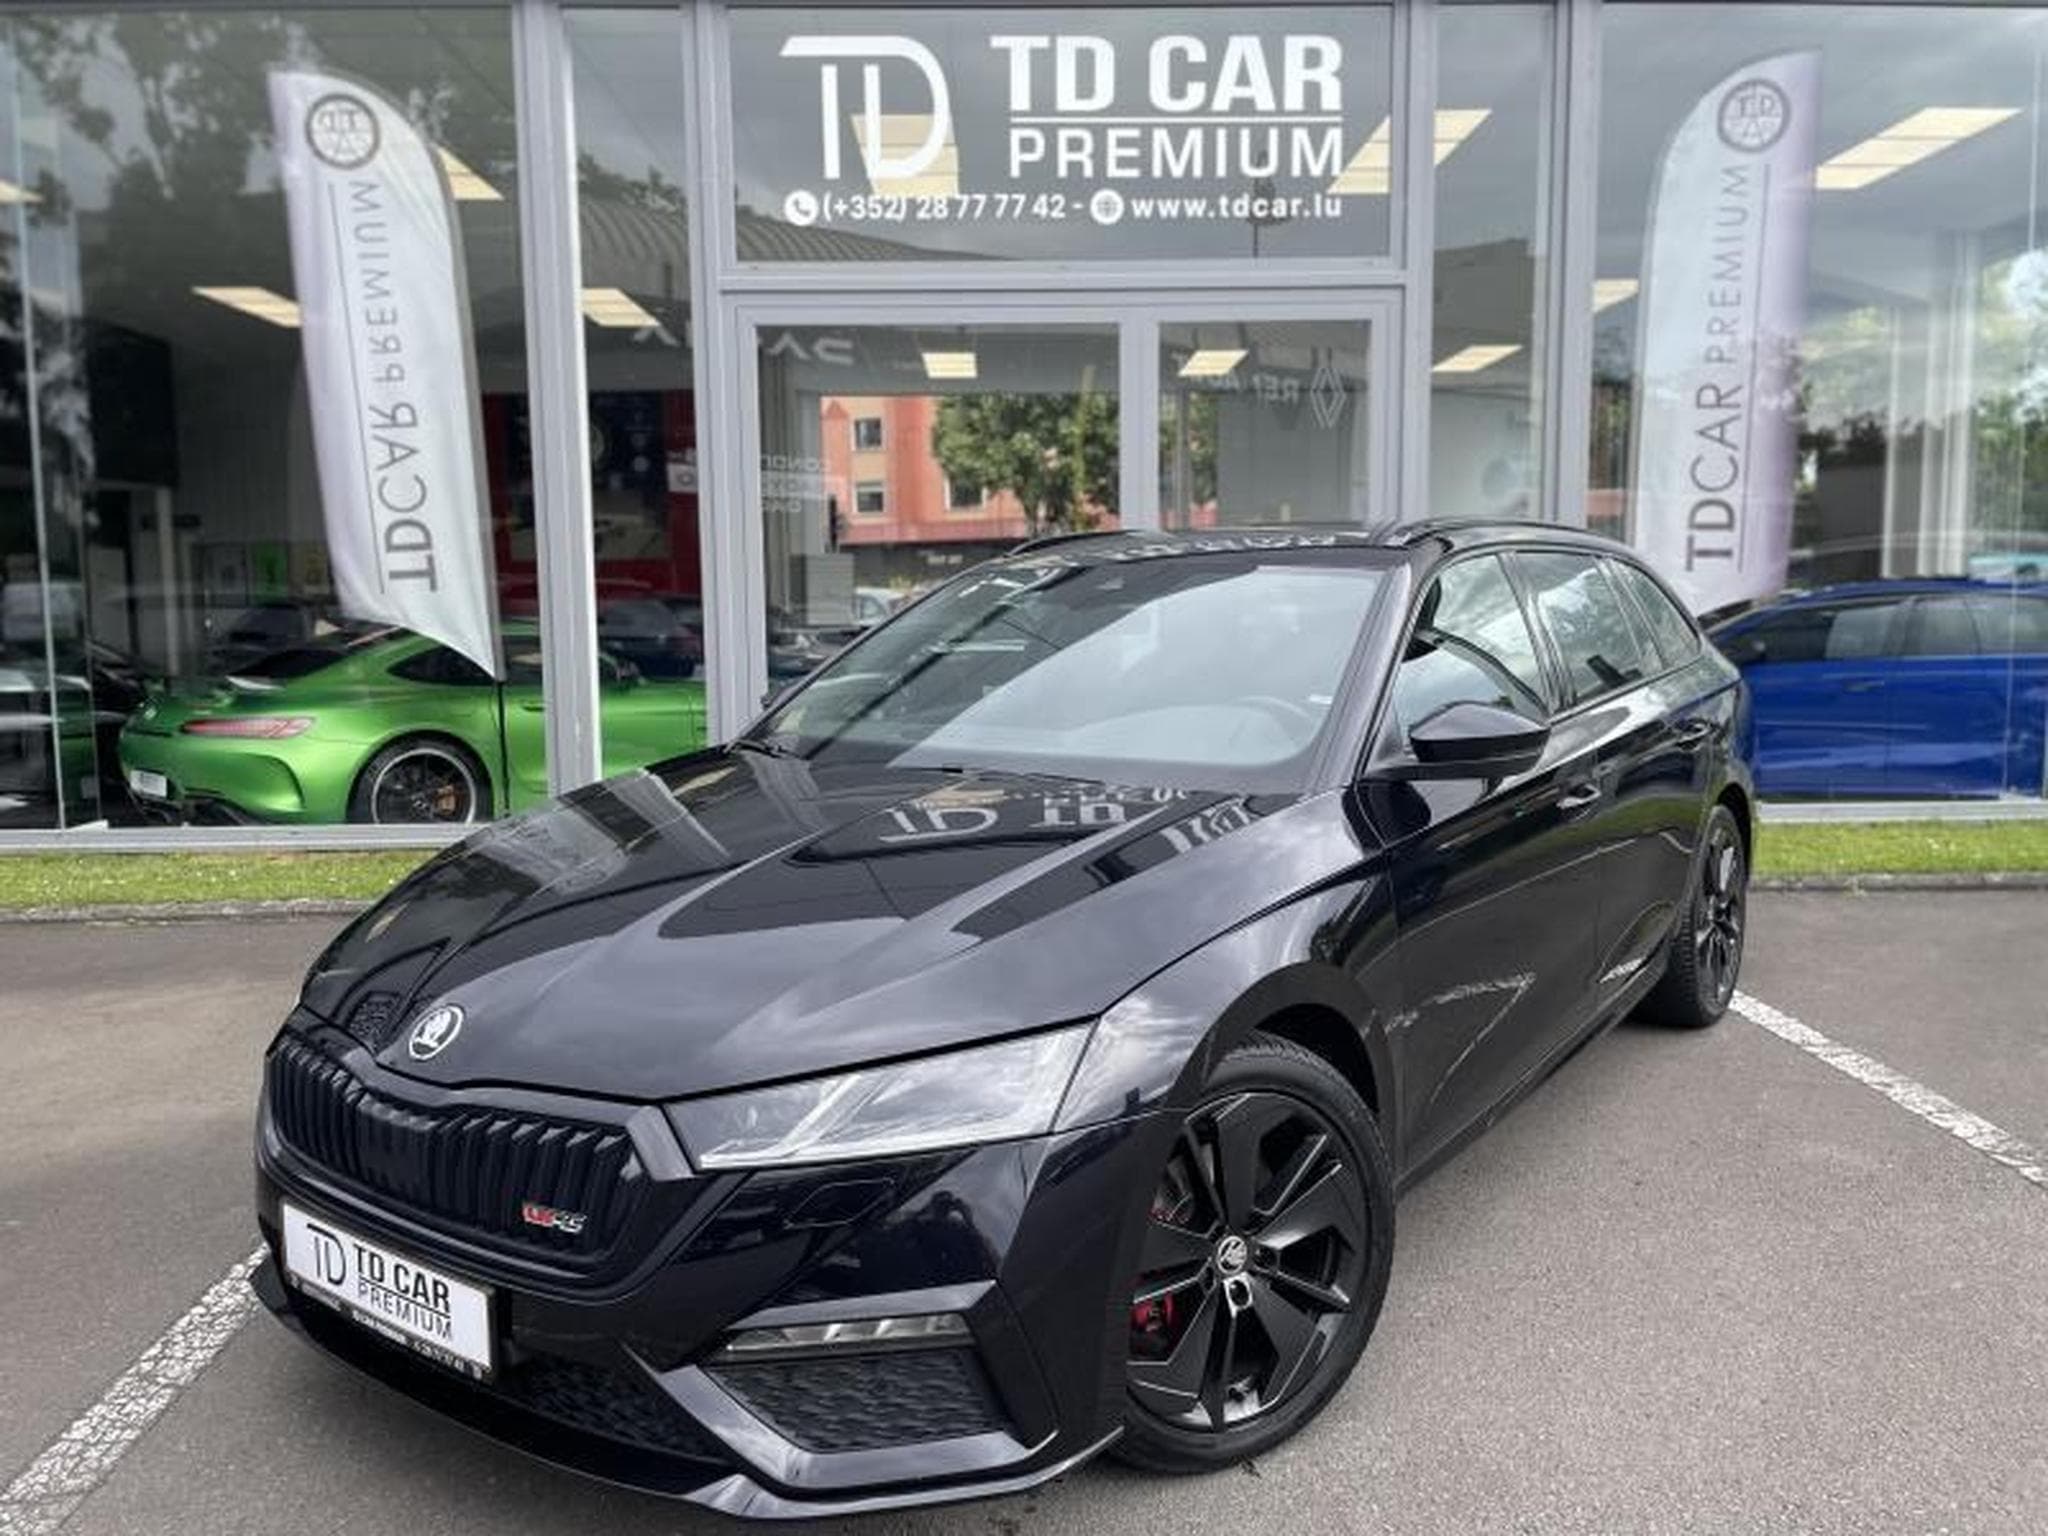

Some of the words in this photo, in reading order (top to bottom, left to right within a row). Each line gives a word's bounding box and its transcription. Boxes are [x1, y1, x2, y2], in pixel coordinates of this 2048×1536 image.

[990, 35, 1115, 111] TD
[1149, 35, 1343, 112] CAR
[1011, 127, 1343, 178] PREMIUM
[823, 193, 909, 223] (+352)
[917, 193, 949, 218] 28
[955, 193, 986, 218] 77
[993, 193, 1025, 218] 77
[1032, 193, 1066, 218] 42
[1132, 193, 1343, 219] www.tdcar.lu
[1707, 162, 1751, 366] PREMIUM
[354, 1242, 386, 1282] TD
[394, 1263, 450, 1314] CAR
[356, 1282, 453, 1340] PREMIUM
